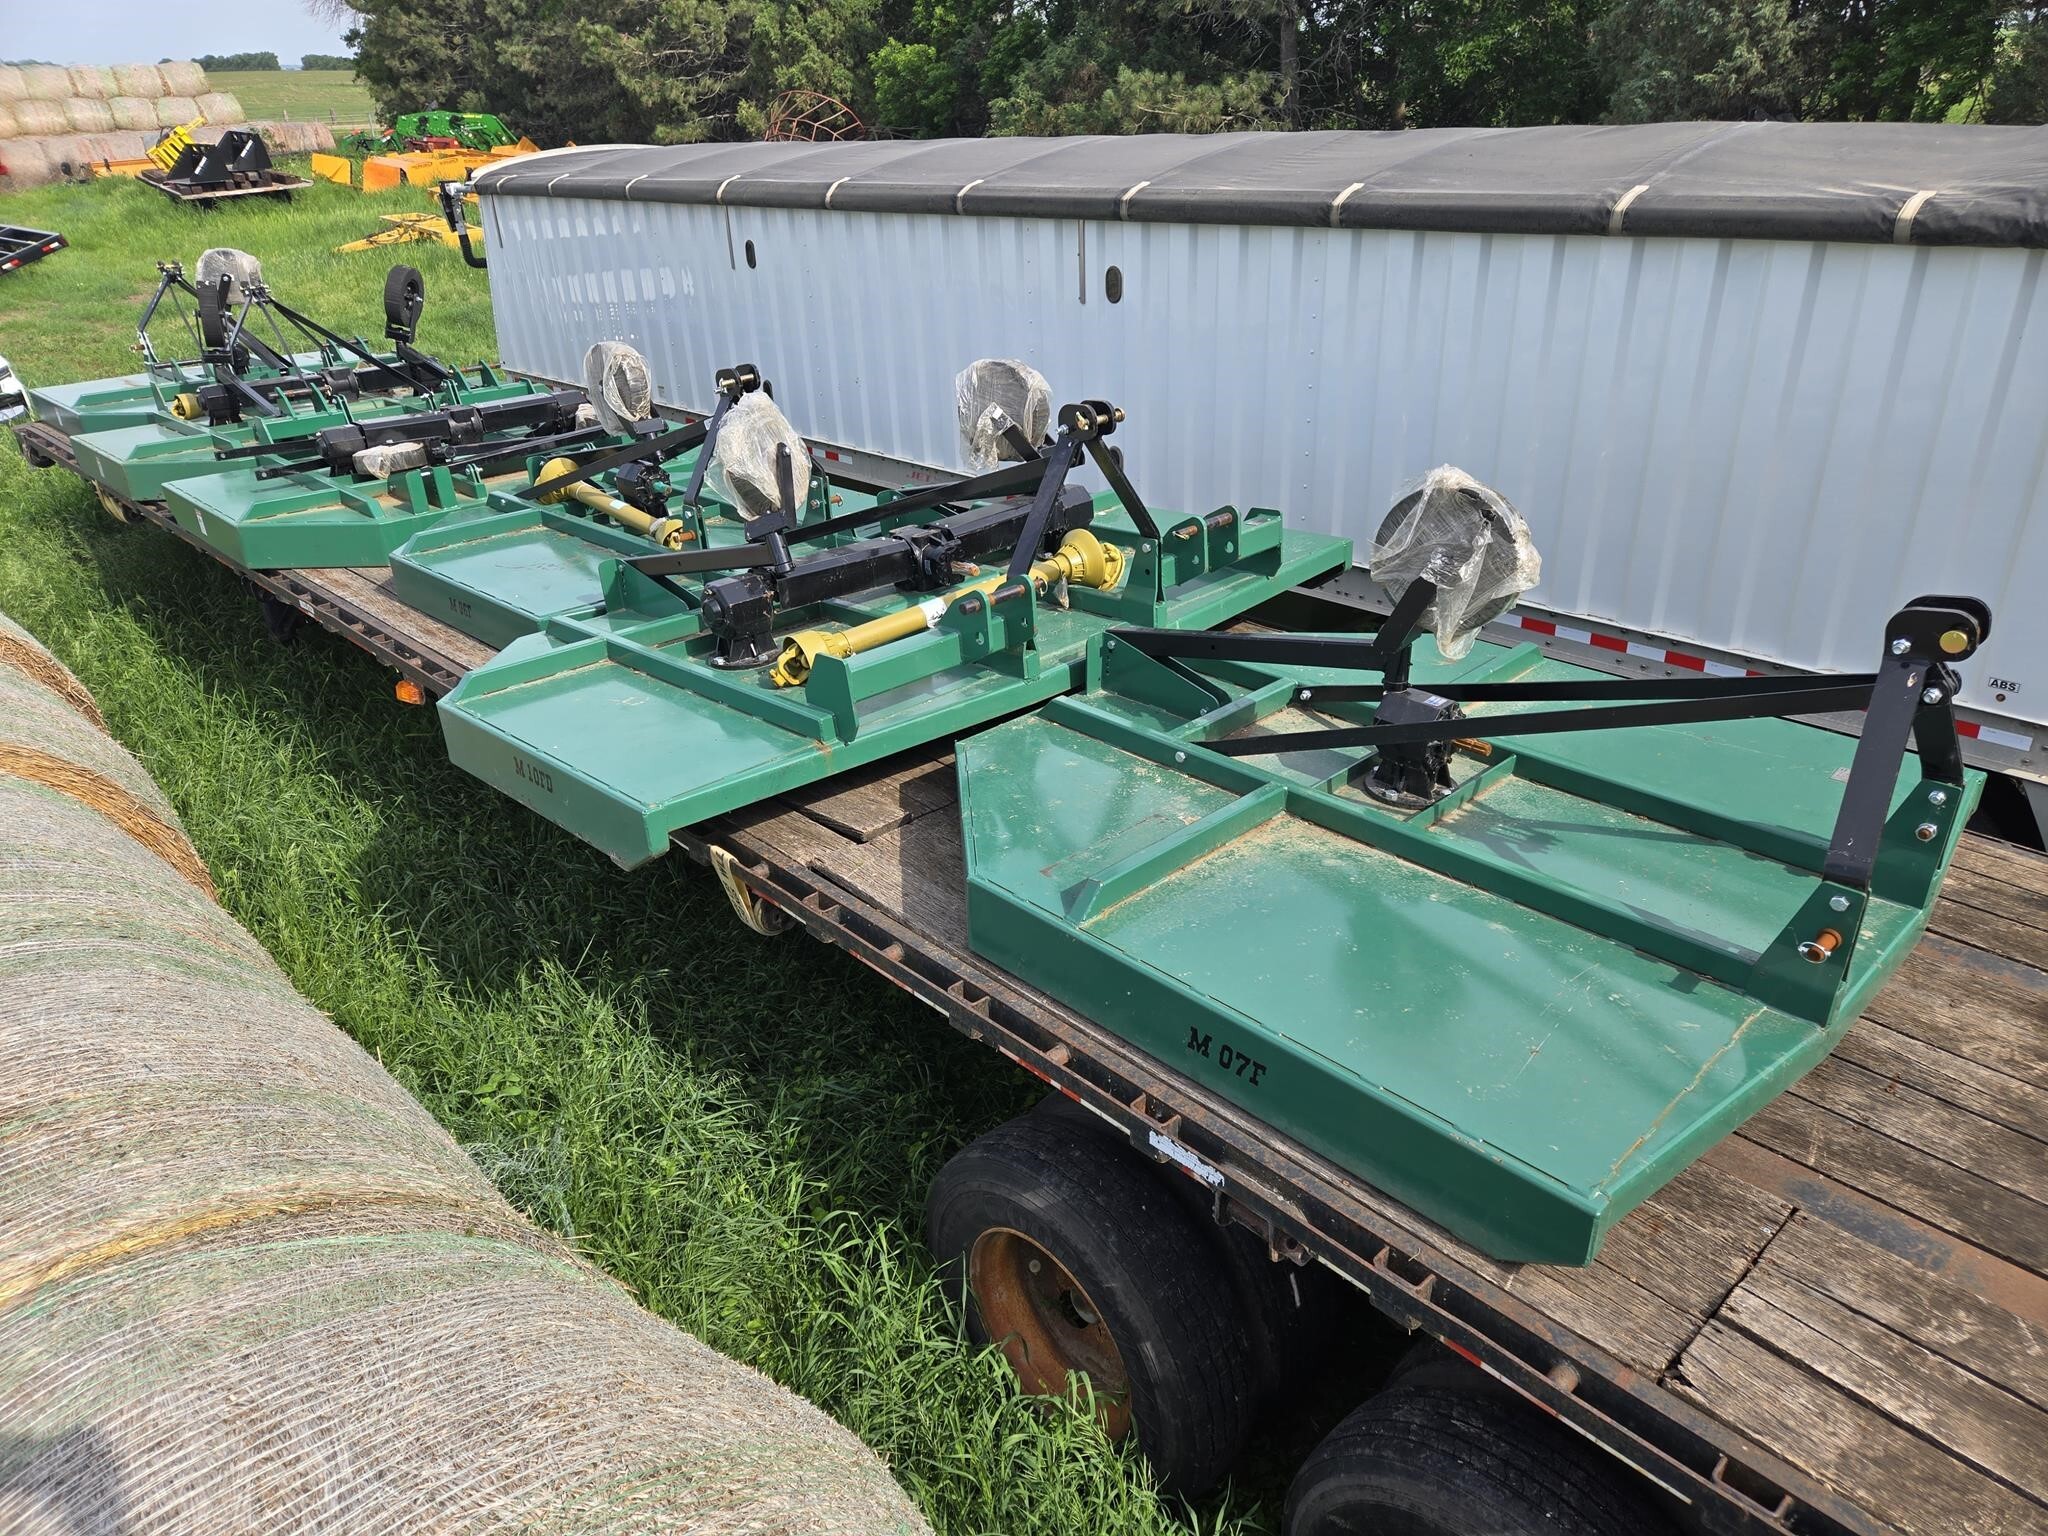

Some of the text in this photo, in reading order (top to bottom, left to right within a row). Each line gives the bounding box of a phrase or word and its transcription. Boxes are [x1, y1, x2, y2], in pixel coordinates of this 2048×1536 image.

[1990, 679, 2017, 691] ABS
[513, 756, 526, 779] M
[1187, 1026, 1213, 1059] M
